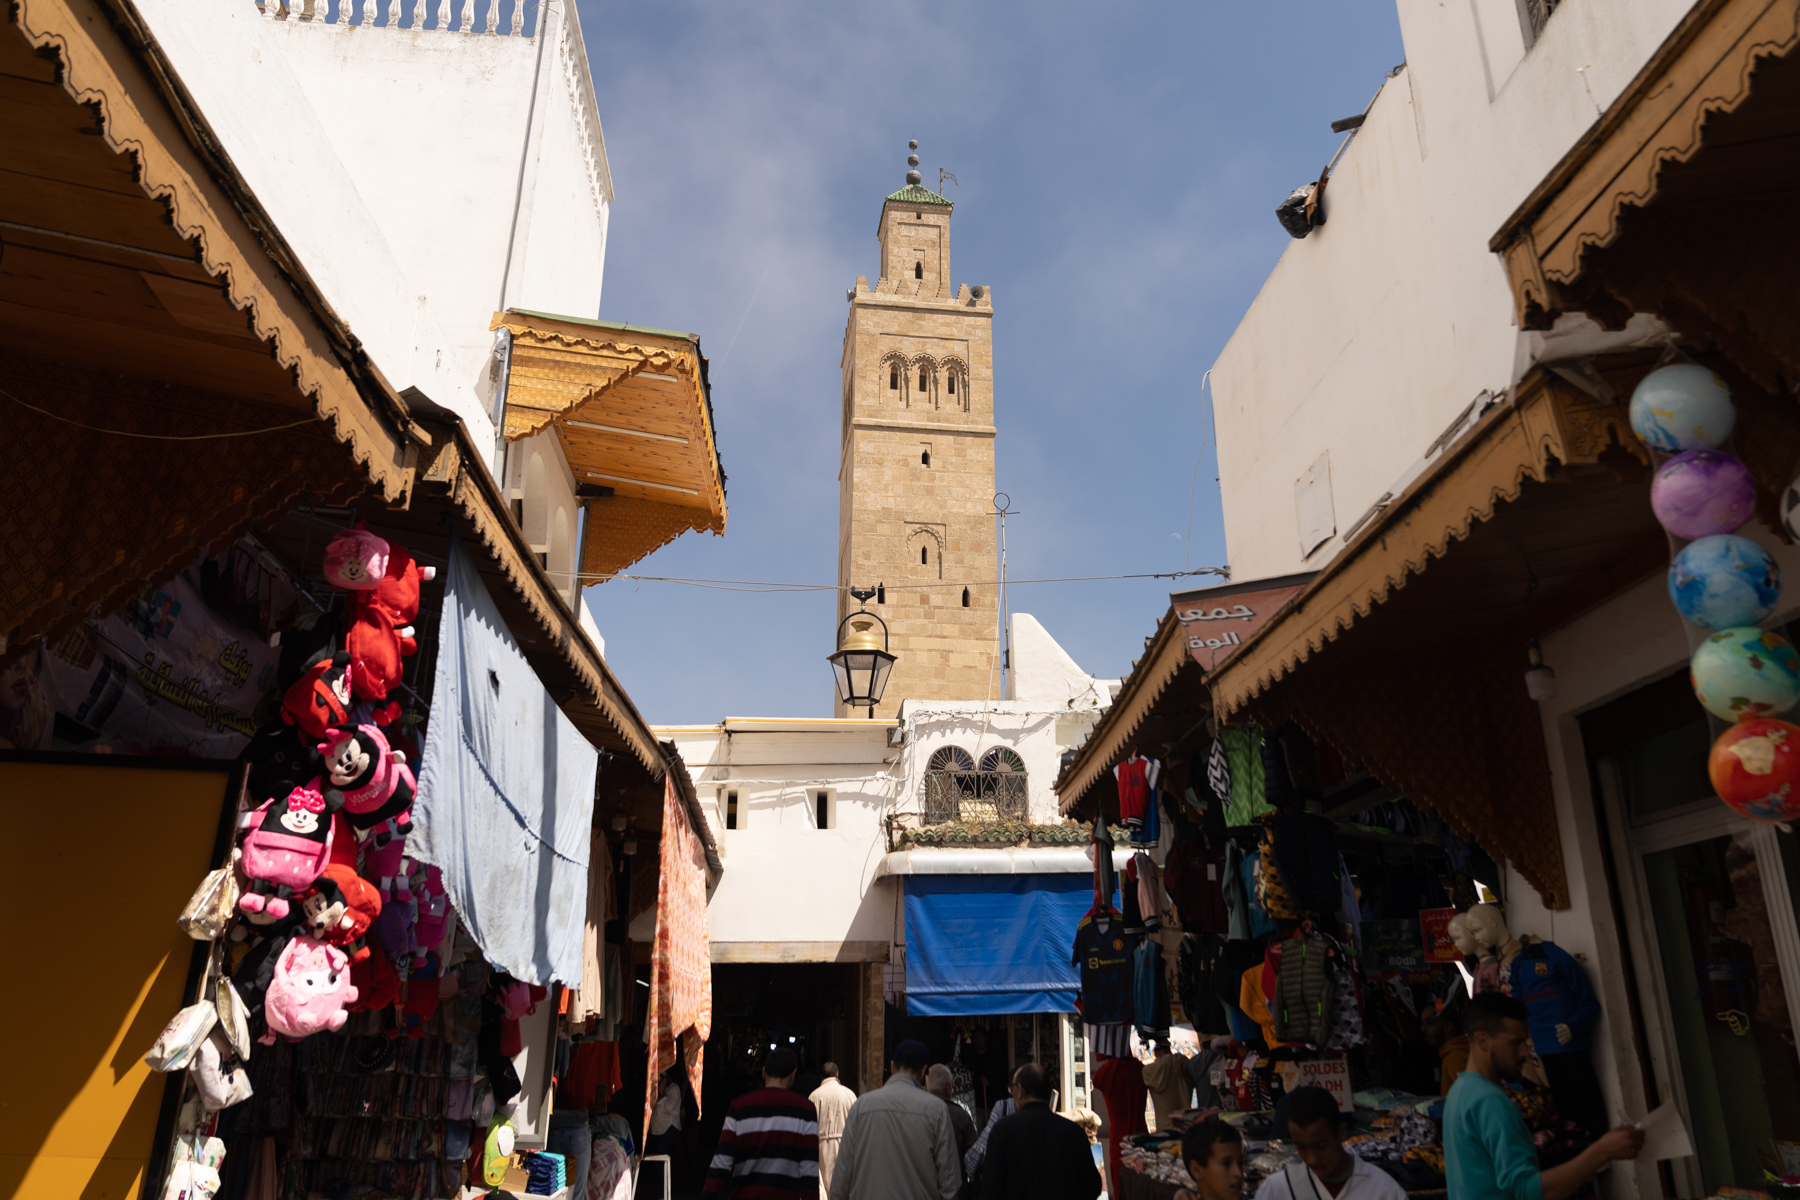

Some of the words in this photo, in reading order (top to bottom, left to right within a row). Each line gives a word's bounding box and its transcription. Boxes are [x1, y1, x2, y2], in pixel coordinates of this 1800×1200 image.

[218, 641, 253, 689] بوتيك
[1388, 955, 1417, 966] 80dh
[1302, 1062, 1346, 1077] SOLDES
[1325, 1079, 1344, 1092] DH
